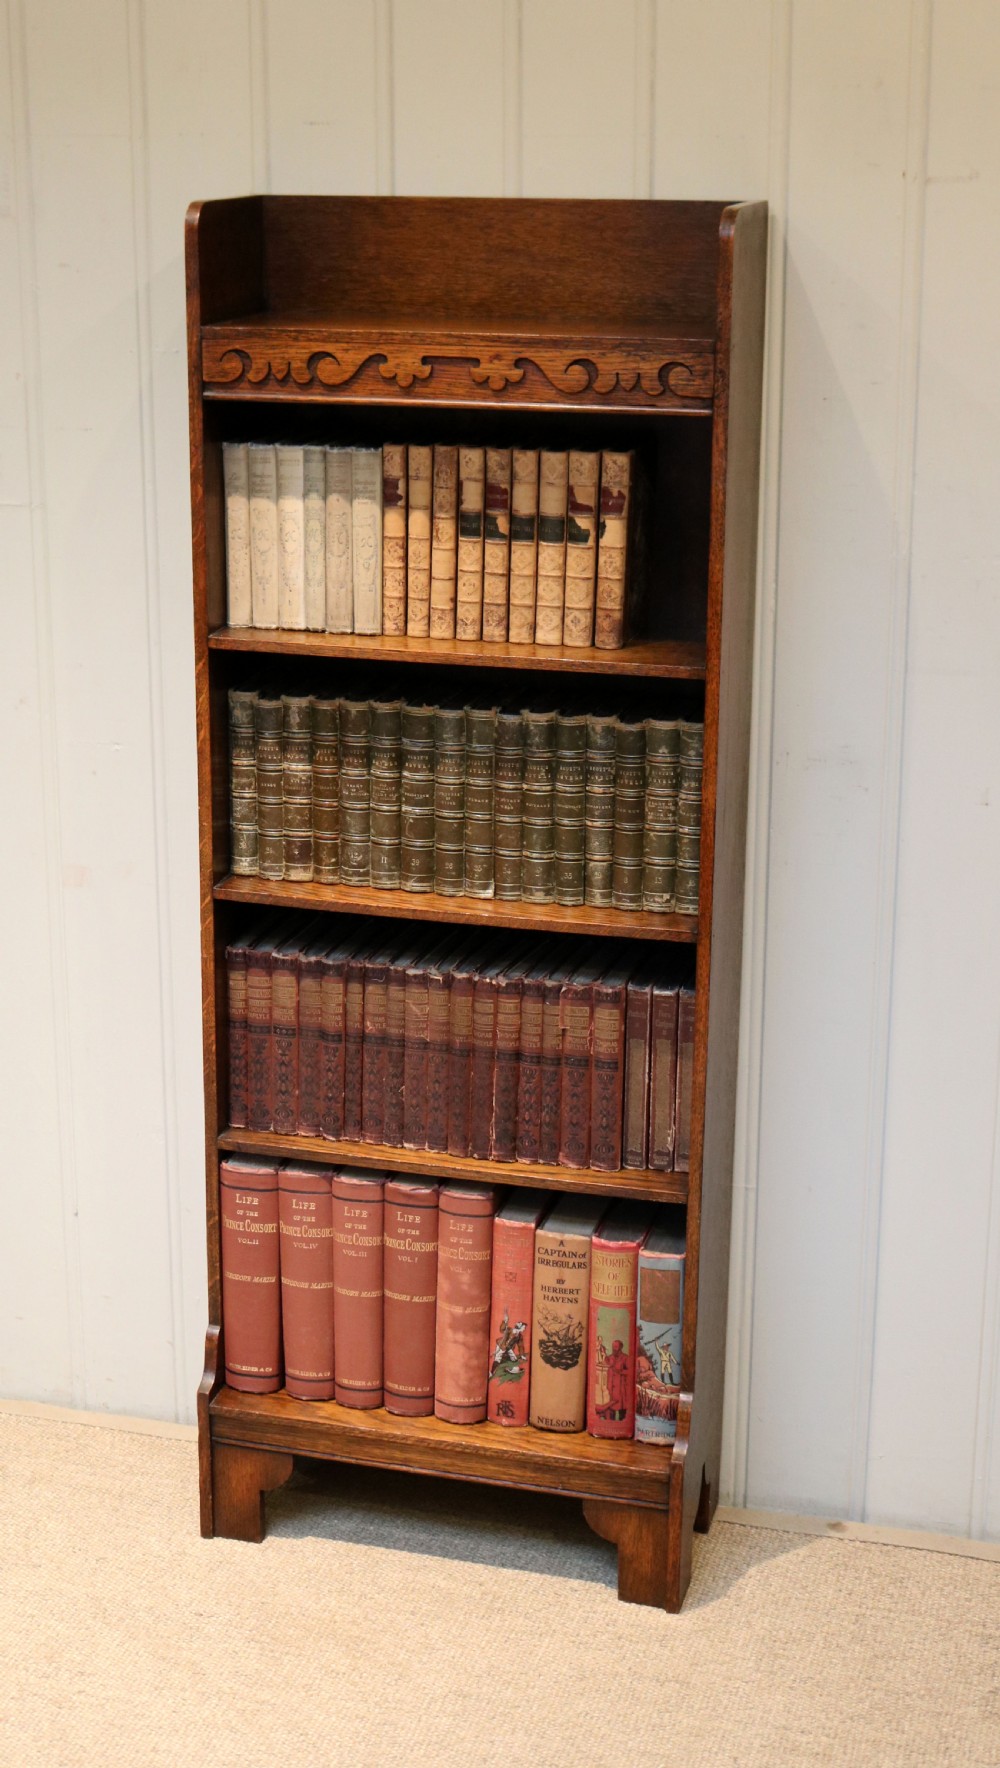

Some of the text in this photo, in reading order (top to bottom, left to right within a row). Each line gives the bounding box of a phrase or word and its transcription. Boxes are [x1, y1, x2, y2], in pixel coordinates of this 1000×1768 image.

[235, 1193, 259, 1205] LIFE
[292, 1199, 316, 1210] LIFE
[343, 1206, 368, 1218] LIFE
[397, 1212, 421, 1223] LIFE
[245, 1219, 278, 1233] CONSORT
[302, 1225, 334, 1238] CONSORT
[449, 1219, 474, 1232] LIFE
[406, 1238, 439, 1252] CONSORT
[537, 1246, 578, 1259] CAPTAIN
[537, 1257, 588, 1270] IRREGULARS
[595, 1255, 634, 1268] STORIES
[607, 1271, 620, 1281] OF
[541, 1284, 581, 1296] HERBERT
[591, 1281, 611, 1296] SELF
[543, 1294, 579, 1304] HAVENS
[537, 1415, 576, 1428] NELSON
